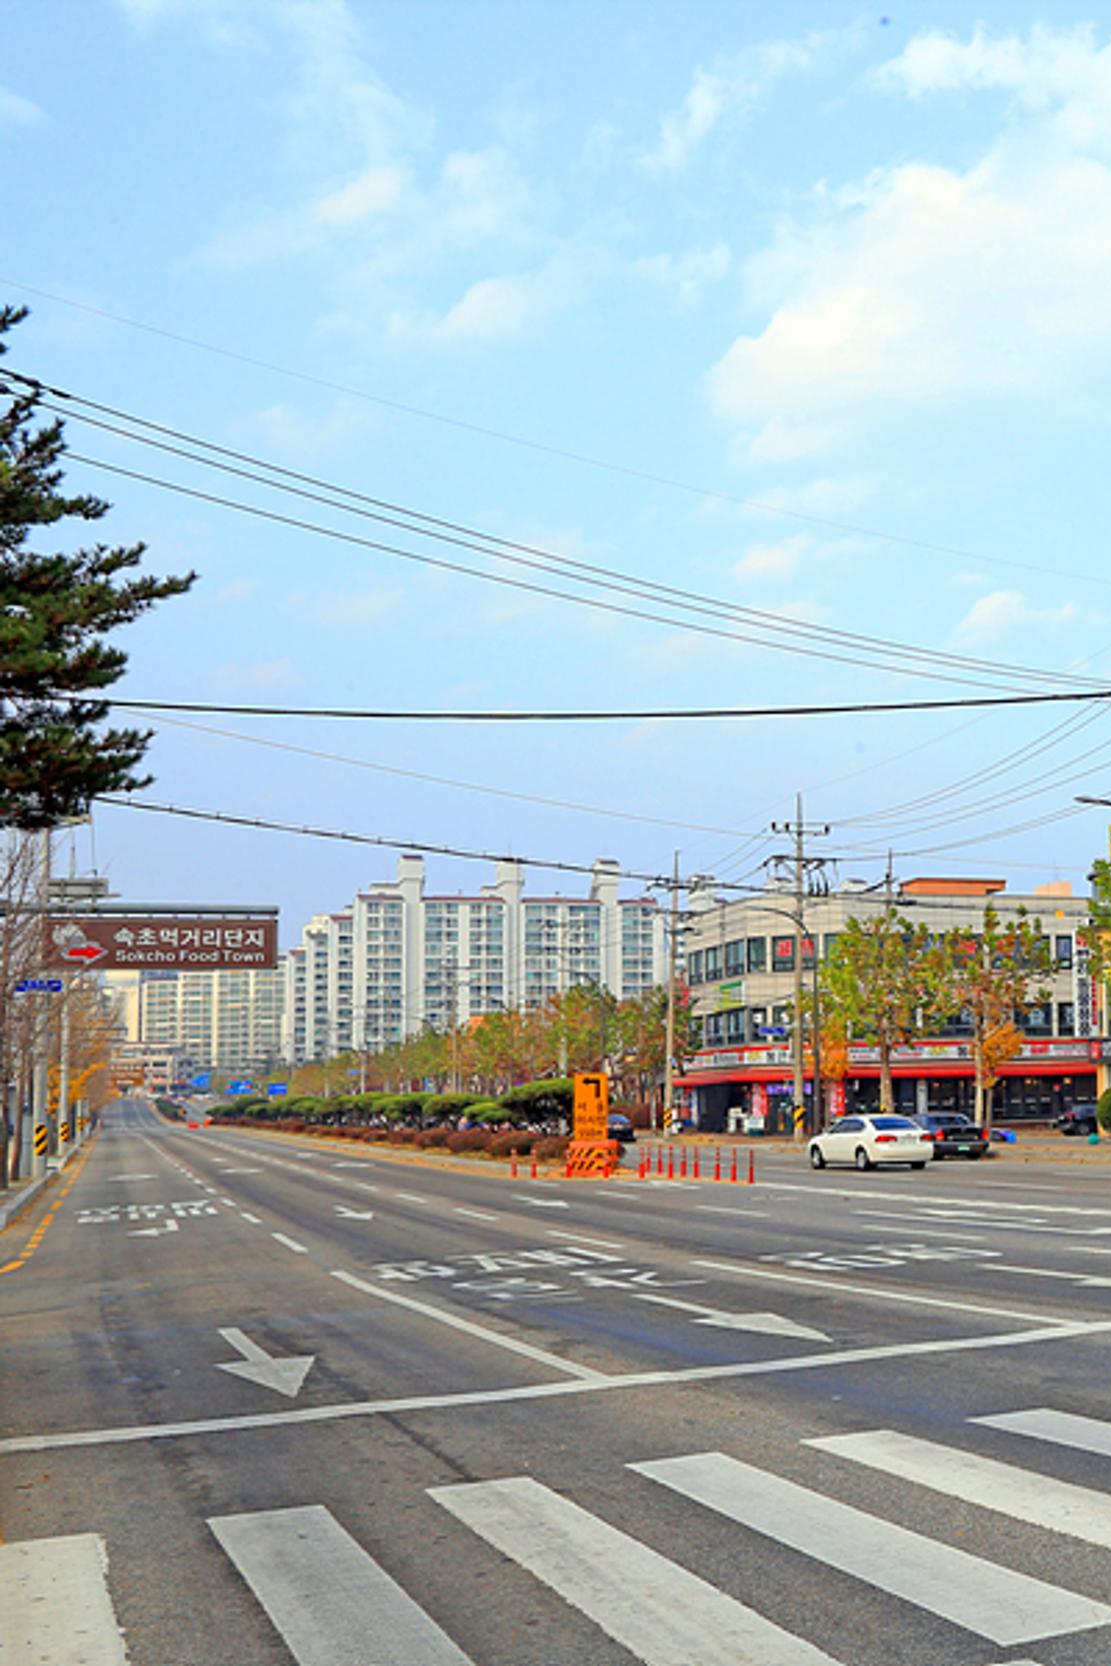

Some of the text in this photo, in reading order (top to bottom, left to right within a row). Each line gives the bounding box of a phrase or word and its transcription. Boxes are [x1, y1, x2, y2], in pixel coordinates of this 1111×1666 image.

[113, 927, 265, 947] 속초먹거리단지
[115, 950, 265, 962] Sokcho Food Town
